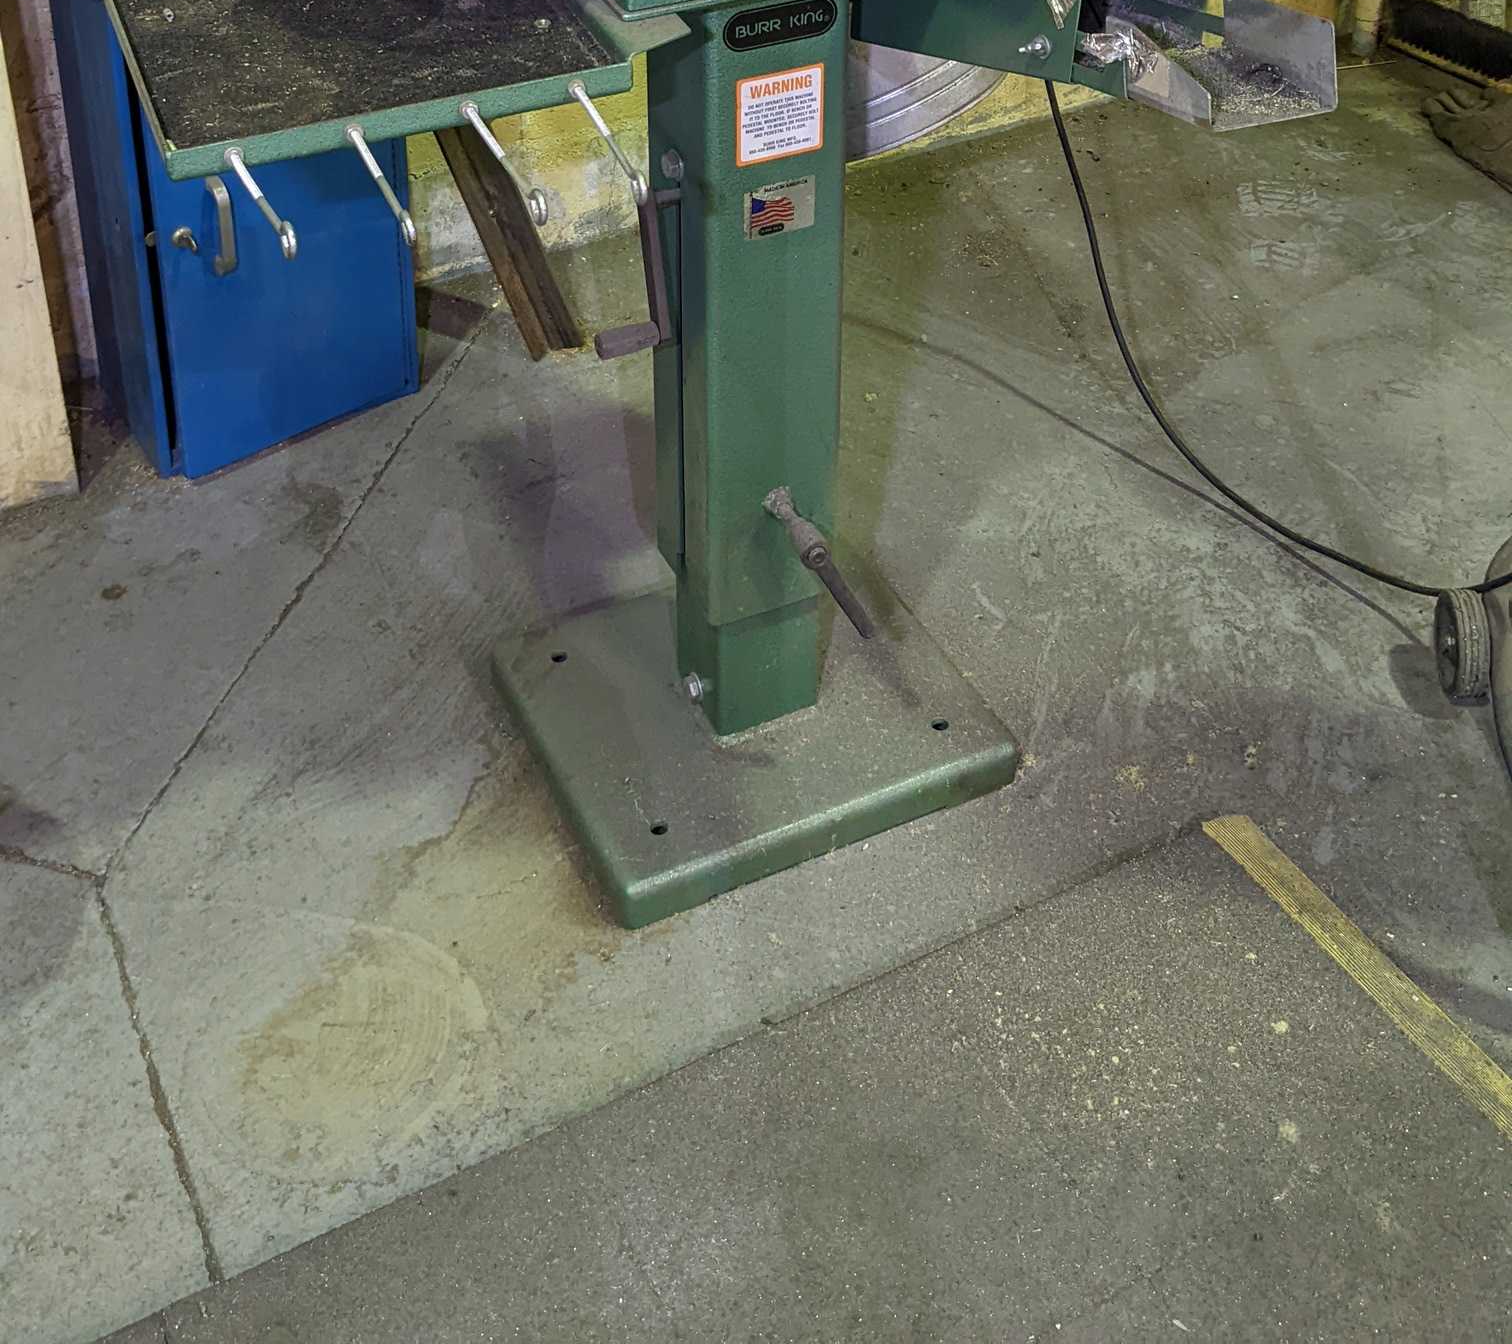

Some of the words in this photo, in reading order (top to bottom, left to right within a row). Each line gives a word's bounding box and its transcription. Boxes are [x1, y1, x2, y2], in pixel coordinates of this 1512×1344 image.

[736, 18, 782, 38] BURR
[790, 10, 824, 28] KING
[750, 74, 813, 99] WARNING
